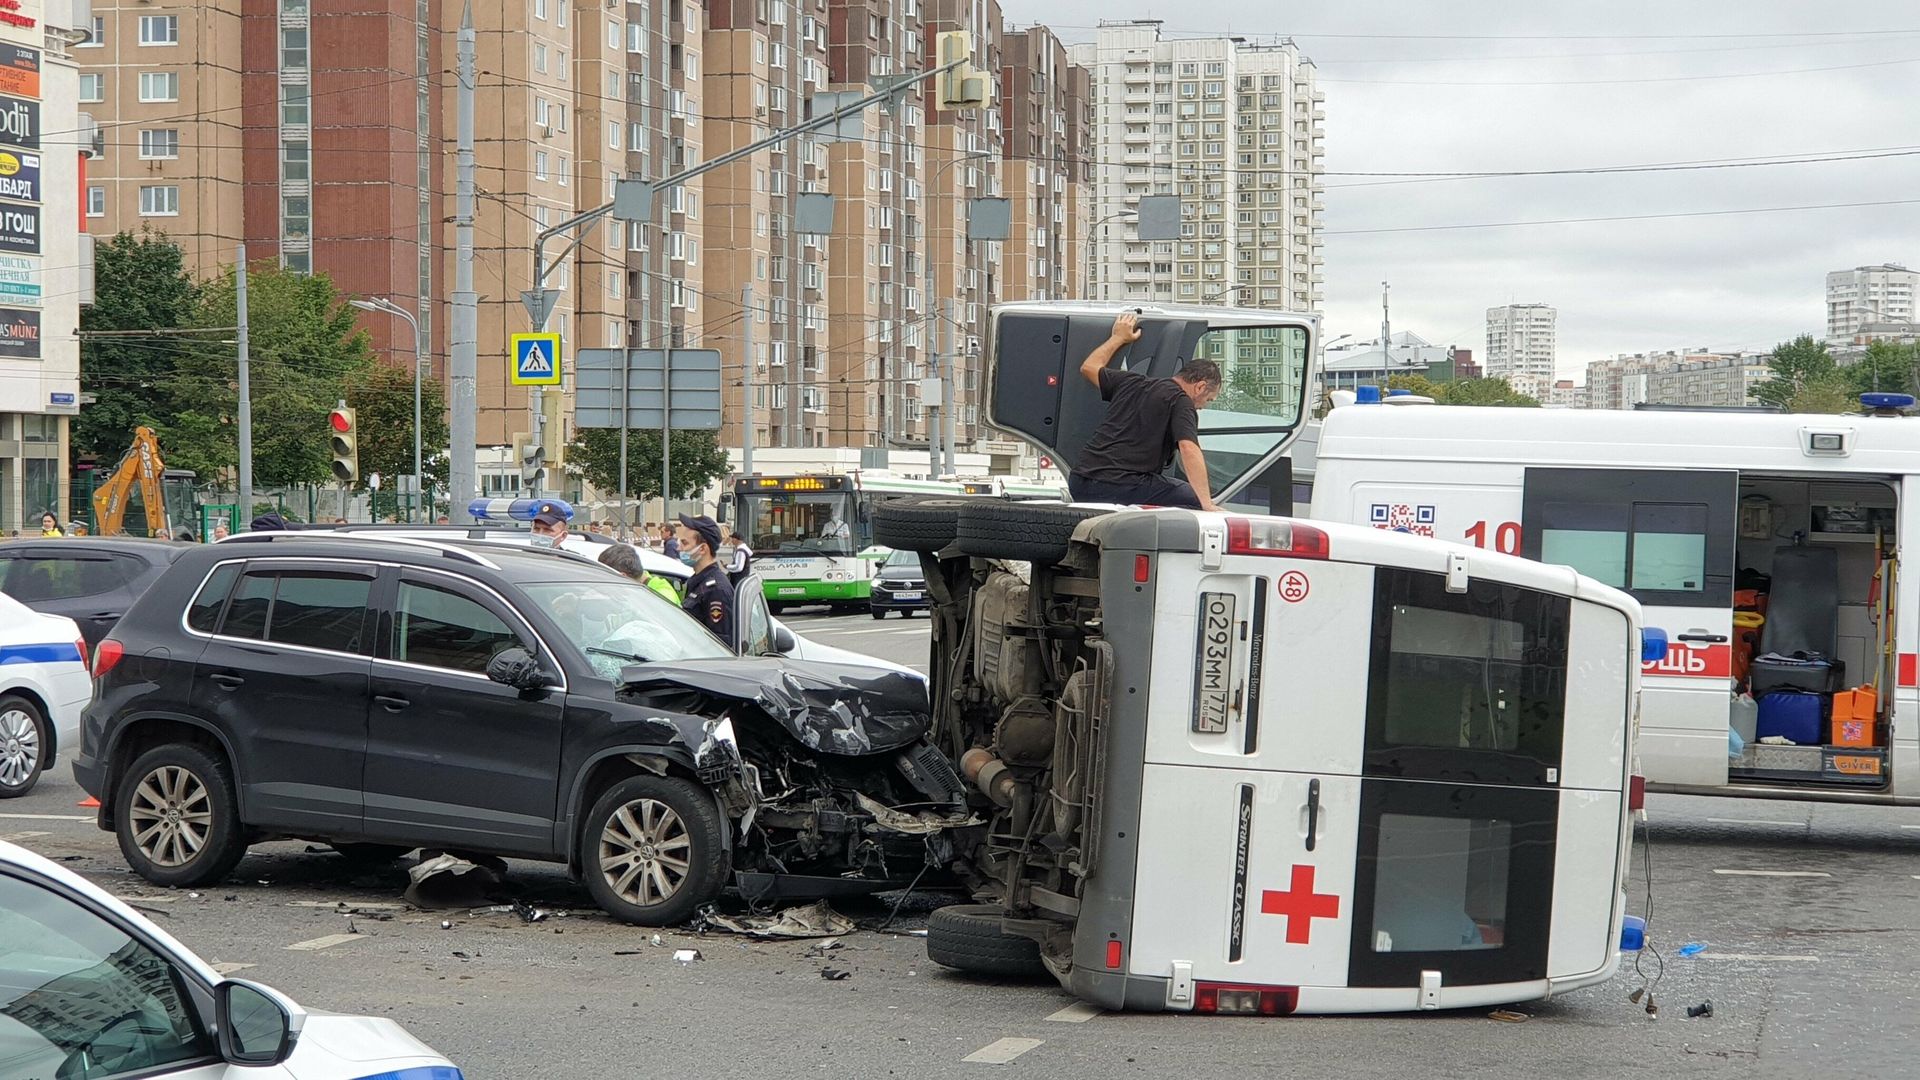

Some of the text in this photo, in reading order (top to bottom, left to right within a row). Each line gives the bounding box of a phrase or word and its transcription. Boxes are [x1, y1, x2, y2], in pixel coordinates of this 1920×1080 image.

[0, 177, 32, 200] БАРД
[5, 211, 35, 234] ГОШ
[1284, 574, 1303, 599] 48
[1208, 692, 1226, 727] 777
[1231, 802, 1251, 947] SPRINTER CLASSIC
